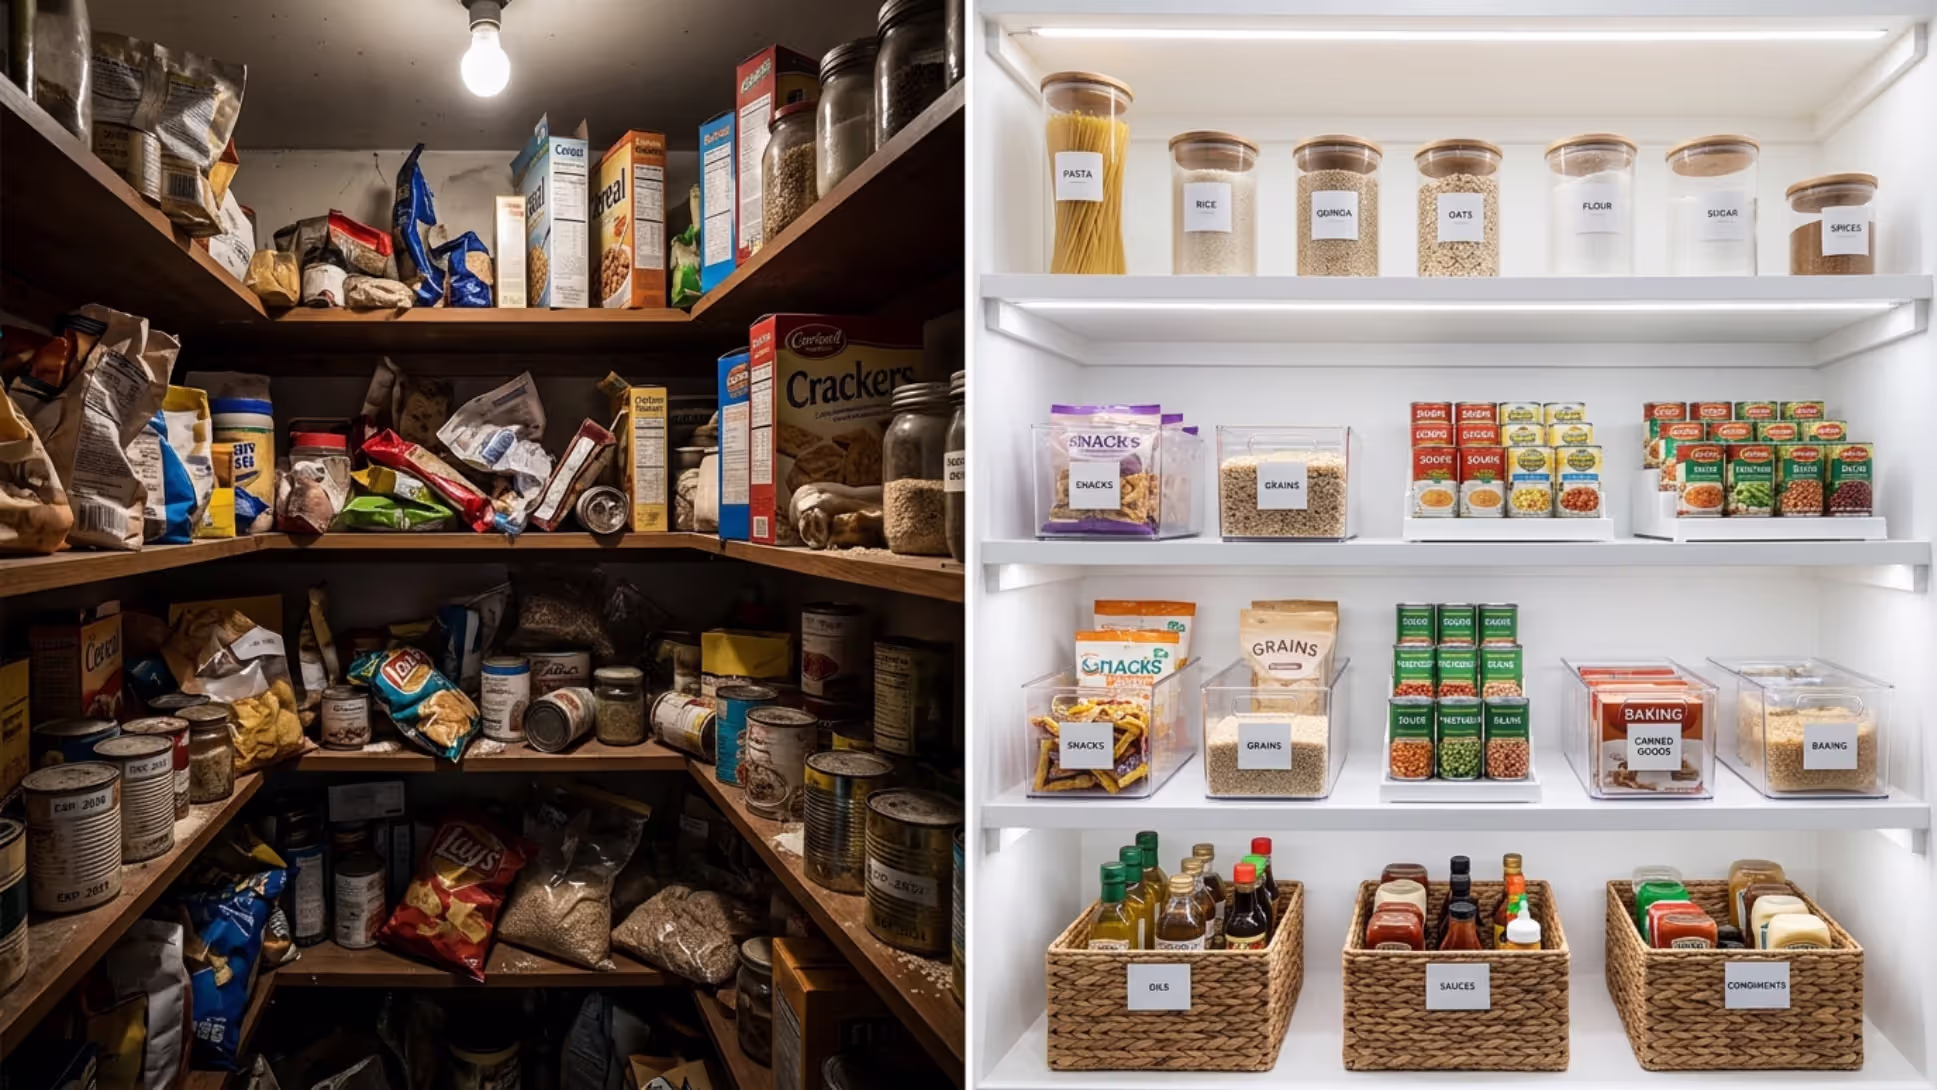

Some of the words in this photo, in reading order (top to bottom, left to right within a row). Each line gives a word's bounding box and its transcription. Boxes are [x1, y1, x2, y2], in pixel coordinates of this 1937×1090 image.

[1063, 169, 1093, 179] PASTA
[1195, 200, 1217, 209] RICE
[1582, 202, 1612, 211] FLOUR
[1448, 210, 1473, 219] OATS
[1707, 209, 1738, 218] SUGAR
[1830, 224, 1862, 233] SPICES
[786, 360, 914, 409] Crackers
[1252, 639, 1318, 658] GRAINS
[1624, 707, 1683, 721] BAKING
[1067, 741, 1105, 750] SNACKS
[1246, 741, 1282, 750] GRAINS
[1148, 983, 1170, 992] OILS
[1439, 982, 1476, 990] SAUCES
